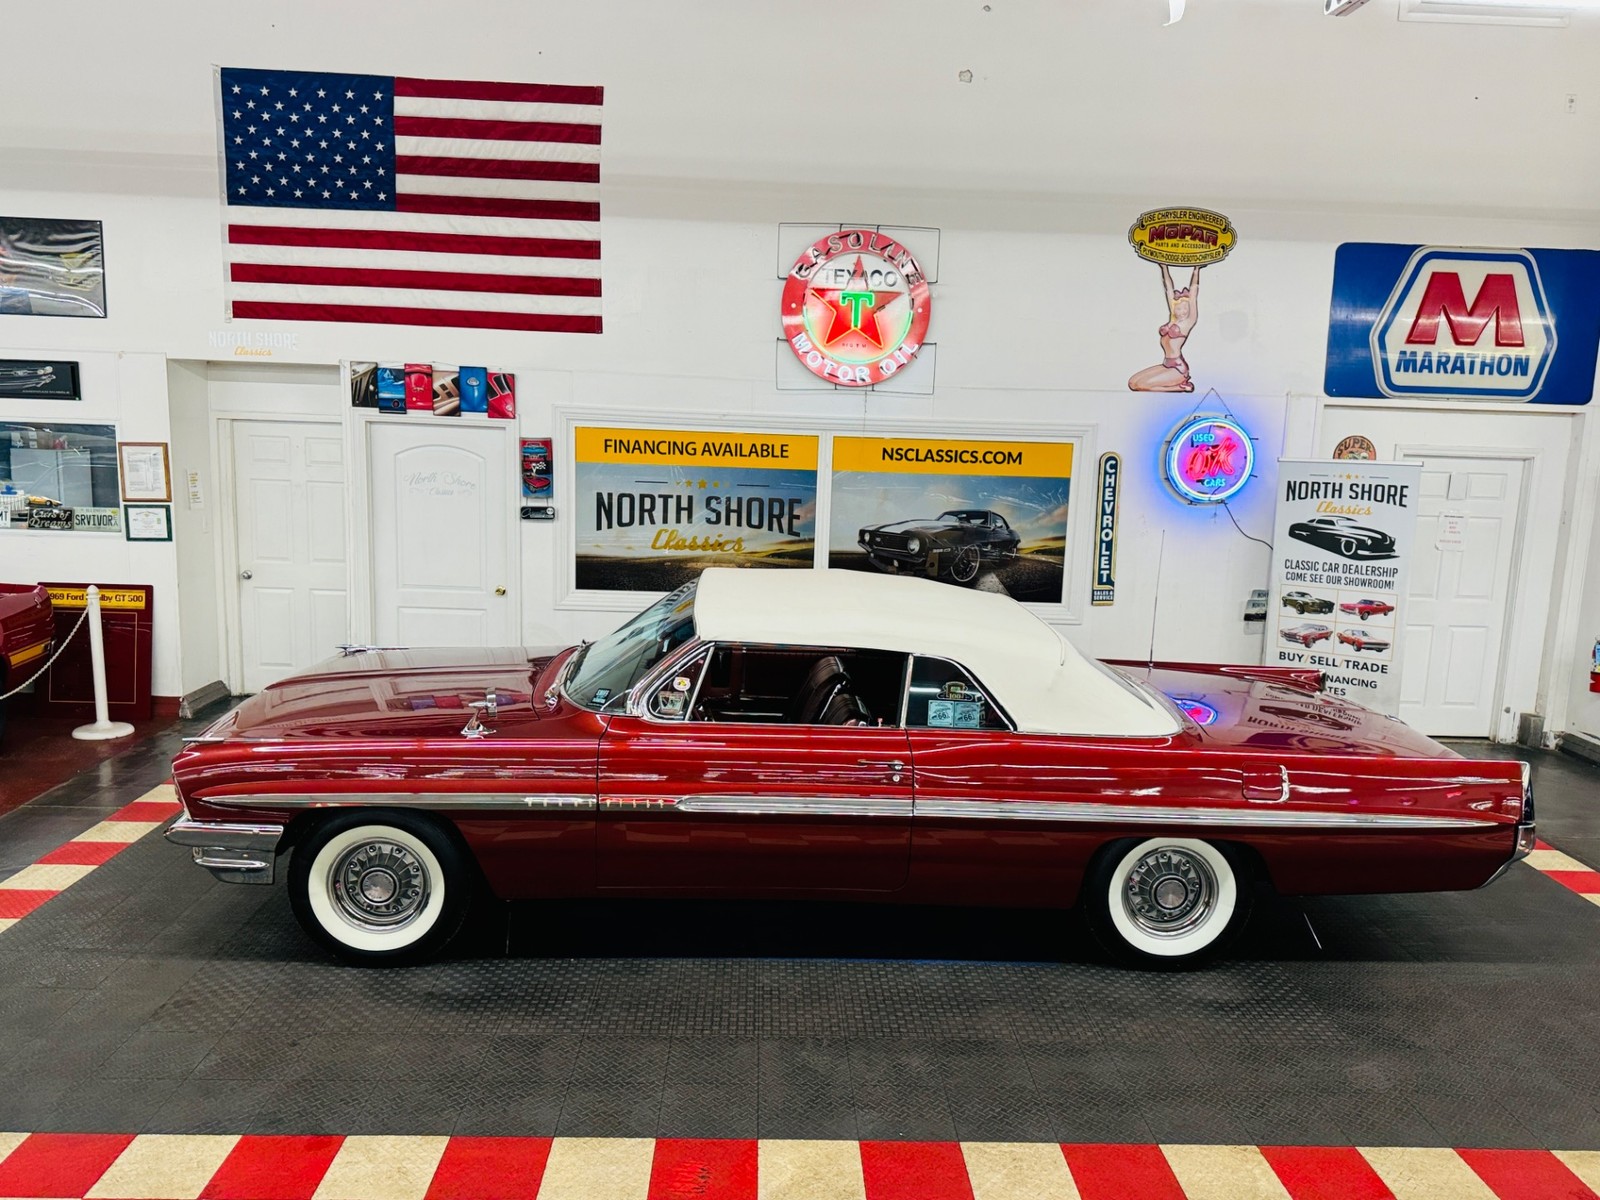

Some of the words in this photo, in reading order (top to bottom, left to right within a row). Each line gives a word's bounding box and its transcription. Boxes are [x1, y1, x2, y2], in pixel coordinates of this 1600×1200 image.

[1144, 213, 1157, 223] USE
[1157, 210, 1188, 221] CHRYSLER
[1188, 211, 1224, 226] ENGINEERED
[1148, 223, 1219, 247] MOPAR
[795, 231, 925, 288] GASOLINE
[821, 267, 898, 287] TEXACO
[839, 290, 875, 330] T
[1404, 271, 1525, 348] M
[207, 330, 252, 348] NORTH
[255, 331, 299, 352] SHORE
[233, 345, 273, 356] Classics
[792, 331, 872, 383] MOTOR
[879, 342, 919, 375] OIL
[1395, 350, 1530, 377] MARATHON
[1192, 433, 1215, 442] USED
[603, 438, 697, 456] FINANCING
[701, 442, 790, 459] AVAILABLE
[881, 447, 1023, 466] NSCLASSICS.COM
[1337, 437, 1372, 459] SUPER
[1203, 478, 1226, 487] CARS
[1285, 480, 1343, 502] NORTH
[1348, 483, 1409, 508] SHORE
[32, 509, 57, 518] Cars
[59, 510, 72, 521] of
[596, 491, 694, 532] NORTH
[704, 495, 802, 538] SHORE
[1316, 501, 1374, 516] Classics
[28, 518, 73, 529] Dreams
[75, 513, 114, 527] SRVIVOR
[1100, 459, 1116, 583] CHEVROLET
[650, 528, 746, 553] Classics
[1284, 558, 1320, 572] CLASSIC
[1322, 562, 1339, 574] CAR
[1342, 564, 1399, 578] DEALERSHIP
[1285, 571, 1308, 582] COME
[1309, 574, 1324, 584] SEE
[1326, 575, 1342, 585] OUR
[1344, 577, 1395, 590] SHOWROOM!
[66, 593, 84, 601] Ford
[114, 594, 127, 602] GT
[127, 594, 144, 603] 500
[1325, 674, 1378, 689] NANCING
